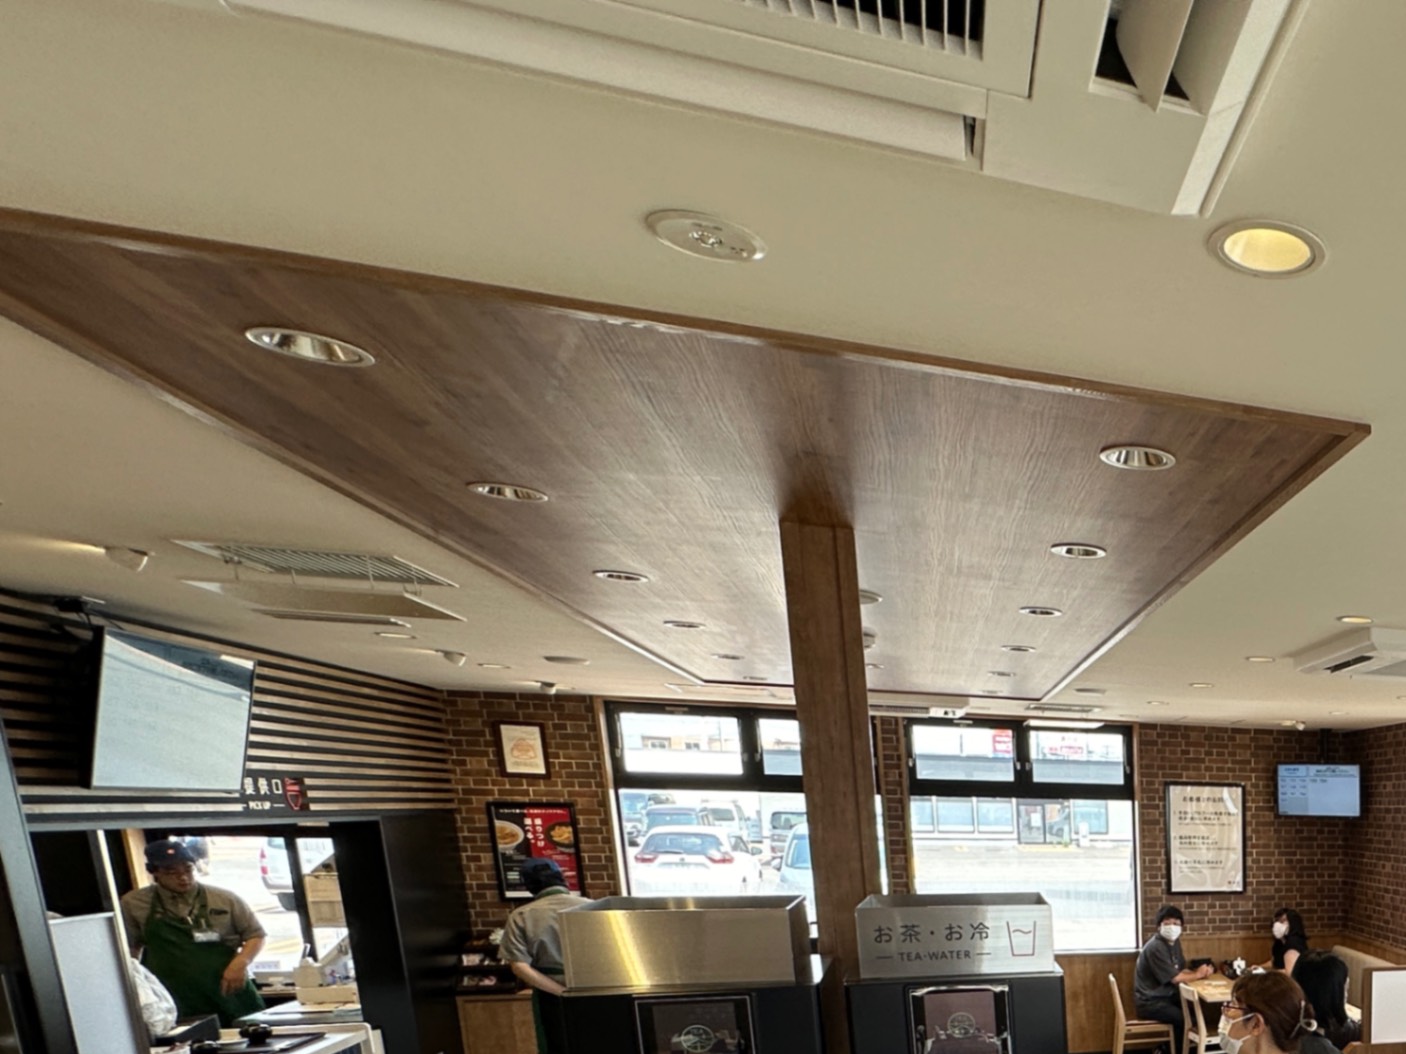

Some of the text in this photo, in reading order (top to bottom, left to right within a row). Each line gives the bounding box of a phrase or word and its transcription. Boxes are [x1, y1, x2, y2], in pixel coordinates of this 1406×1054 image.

[873, 921, 990, 944] お茶・お冷
